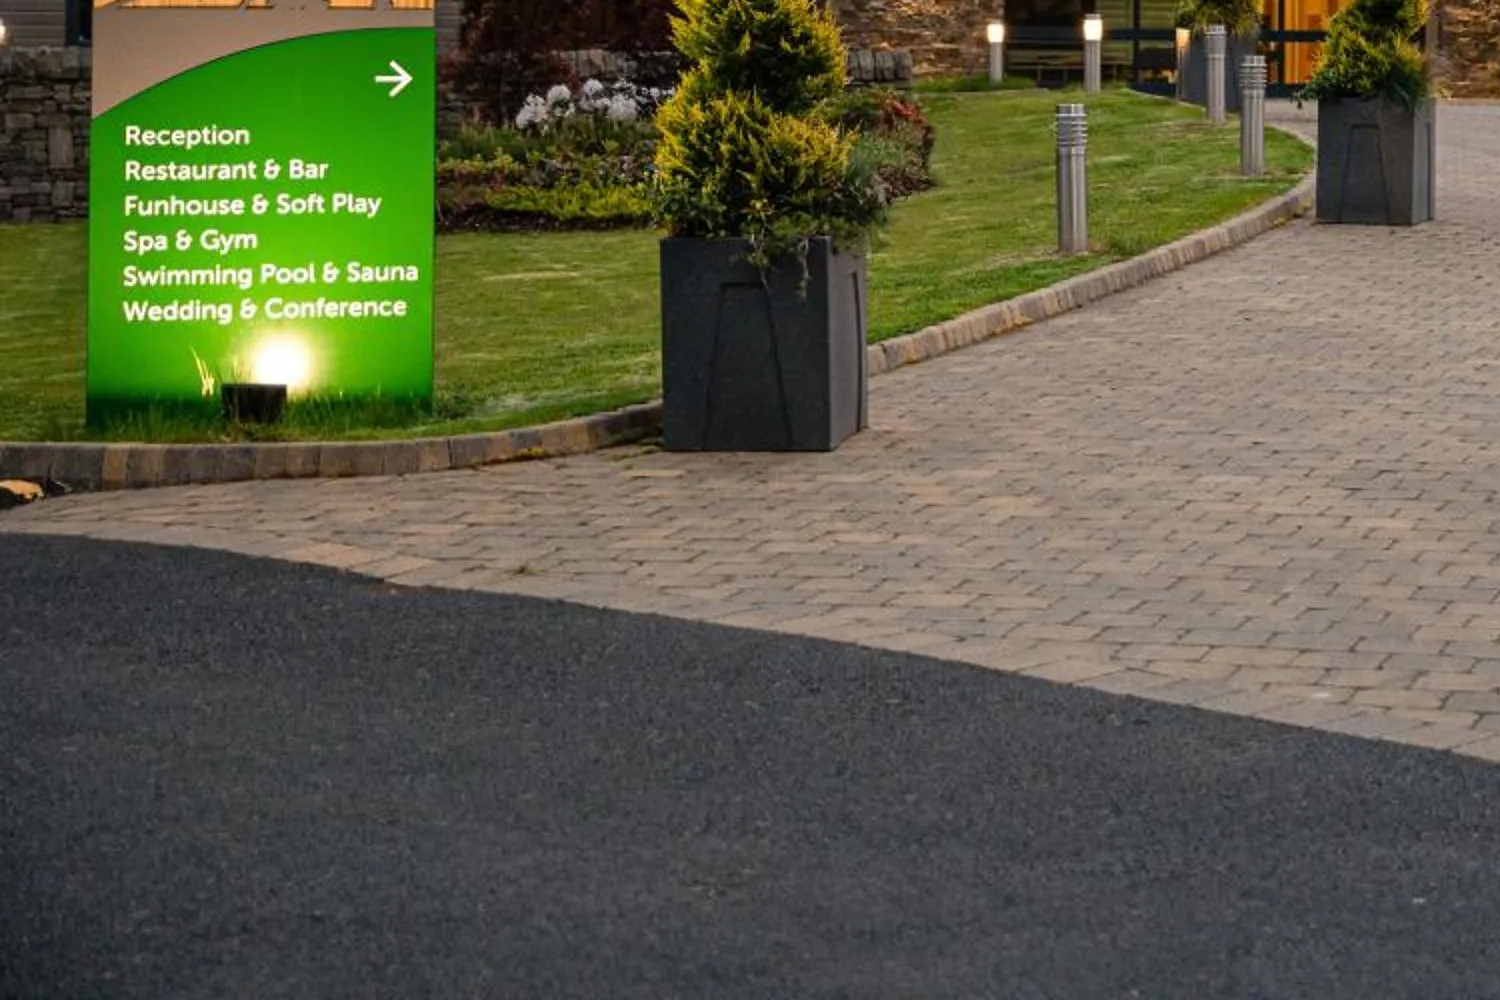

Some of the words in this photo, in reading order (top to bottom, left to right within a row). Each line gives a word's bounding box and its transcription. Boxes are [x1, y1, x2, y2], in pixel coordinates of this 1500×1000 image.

[125, 125, 250, 150] Reception
[125, 160, 257, 181] Restaurant
[263, 158, 281, 180] &
[289, 158, 329, 180] Bar
[125, 195, 245, 217] Funhouse
[251, 193, 269, 215] &
[276, 193, 325, 215] Soft
[332, 192, 382, 218] Play
[123, 230, 168, 255] Spa
[175, 229, 193, 251] &
[199, 229, 258, 255] Gym
[123, 264, 253, 290] Swimming
[260, 263, 316, 284] Pool
[322, 262, 341, 284] &
[347, 261, 419, 283] Sauna
[123, 299, 233, 325] Wedding
[239, 298, 258, 321] &
[263, 297, 407, 321] Conference
